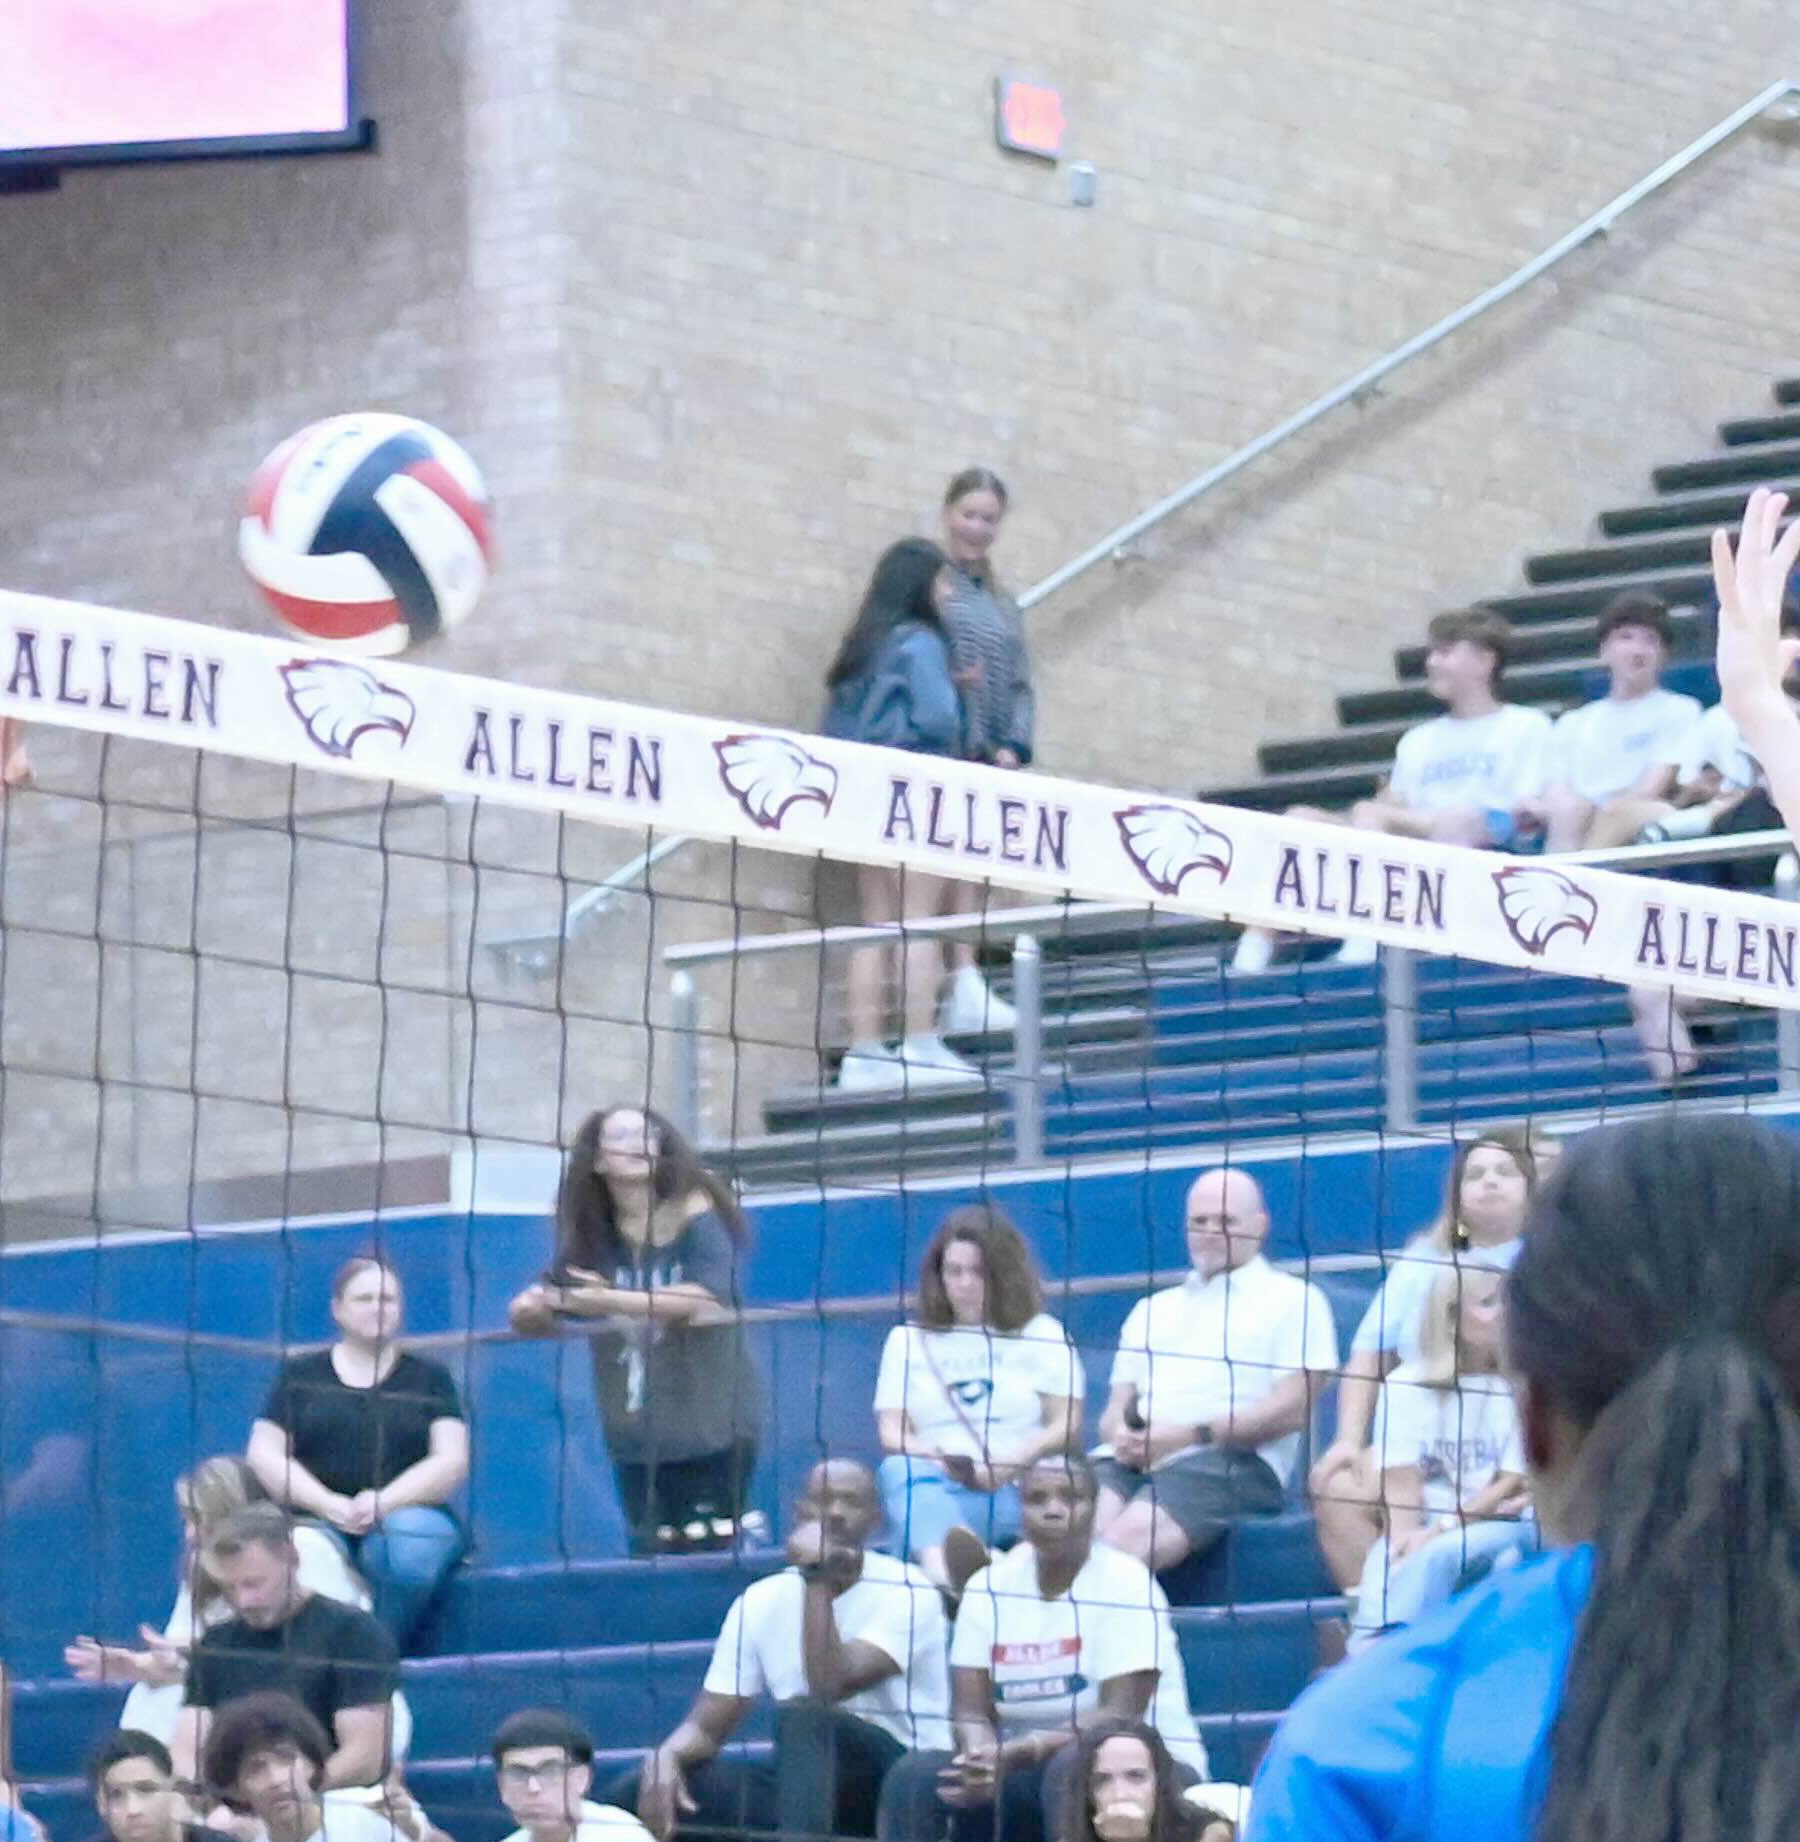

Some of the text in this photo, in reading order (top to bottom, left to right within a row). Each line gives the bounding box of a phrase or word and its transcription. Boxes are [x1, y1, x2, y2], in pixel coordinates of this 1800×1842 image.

[4, 628, 225, 730] ALLEN
[463, 707, 666, 803] ALLEN
[882, 777, 1071, 872] ALLEN
[1274, 844, 1447, 930] ALLEN
[1636, 903, 1798, 989] ALLEN
